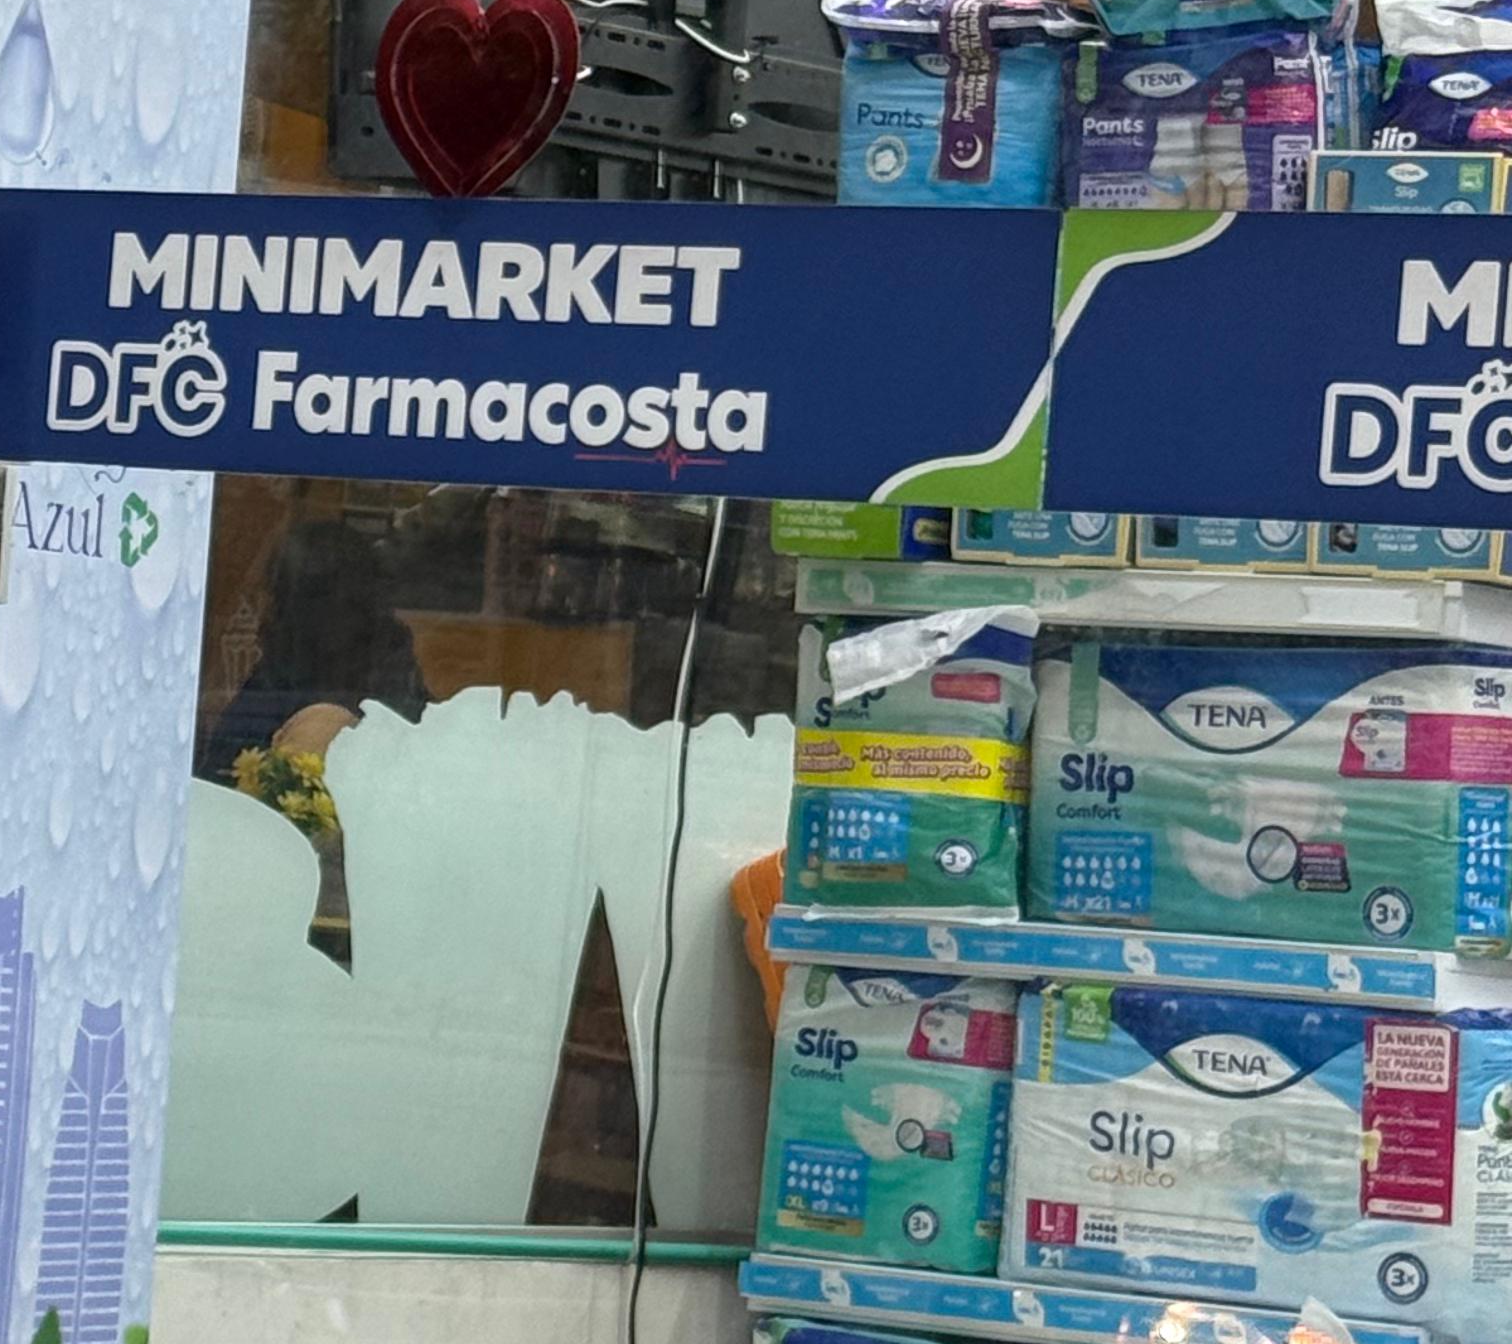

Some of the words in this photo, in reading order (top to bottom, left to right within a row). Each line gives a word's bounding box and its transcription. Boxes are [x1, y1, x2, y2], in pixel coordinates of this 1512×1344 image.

[1137, 72, 1184, 88] TENA
[856, 103, 925, 130] Pants
[1082, 116, 1145, 136] Pants
[108, 231, 742, 328] MINIMARKET
[45, 338, 228, 438] DFC
[252, 349, 768, 454] Farmacosta
[11, 480, 106, 559] Azul
[1474, 677, 1505, 699] Slip
[1186, 703, 1267, 729] TENA
[890, 763, 938, 777] mismo
[940, 764, 990, 781] precio
[1059, 753, 1135, 804] Slip
[1056, 802, 1122, 820] Comfort
[1375, 903, 1401, 924] 3x
[863, 981, 906, 1003] TENA
[794, 1026, 859, 1070] Slip
[1376, 1032, 1395, 1046] LA
[1396, 1033, 1445, 1048] NUEVA
[790, 1063, 846, 1083] Comfort
[1192, 1049, 1268, 1076] TENA
[1375, 1058, 1391, 1070] DE
[1404, 1071, 1445, 1085] CERCA
[1088, 1111, 1176, 1169] Slip
[1040, 1203, 1055, 1232] L
[1039, 1248, 1063, 1269] 21
[1390, 1268, 1415, 1287] 3x
